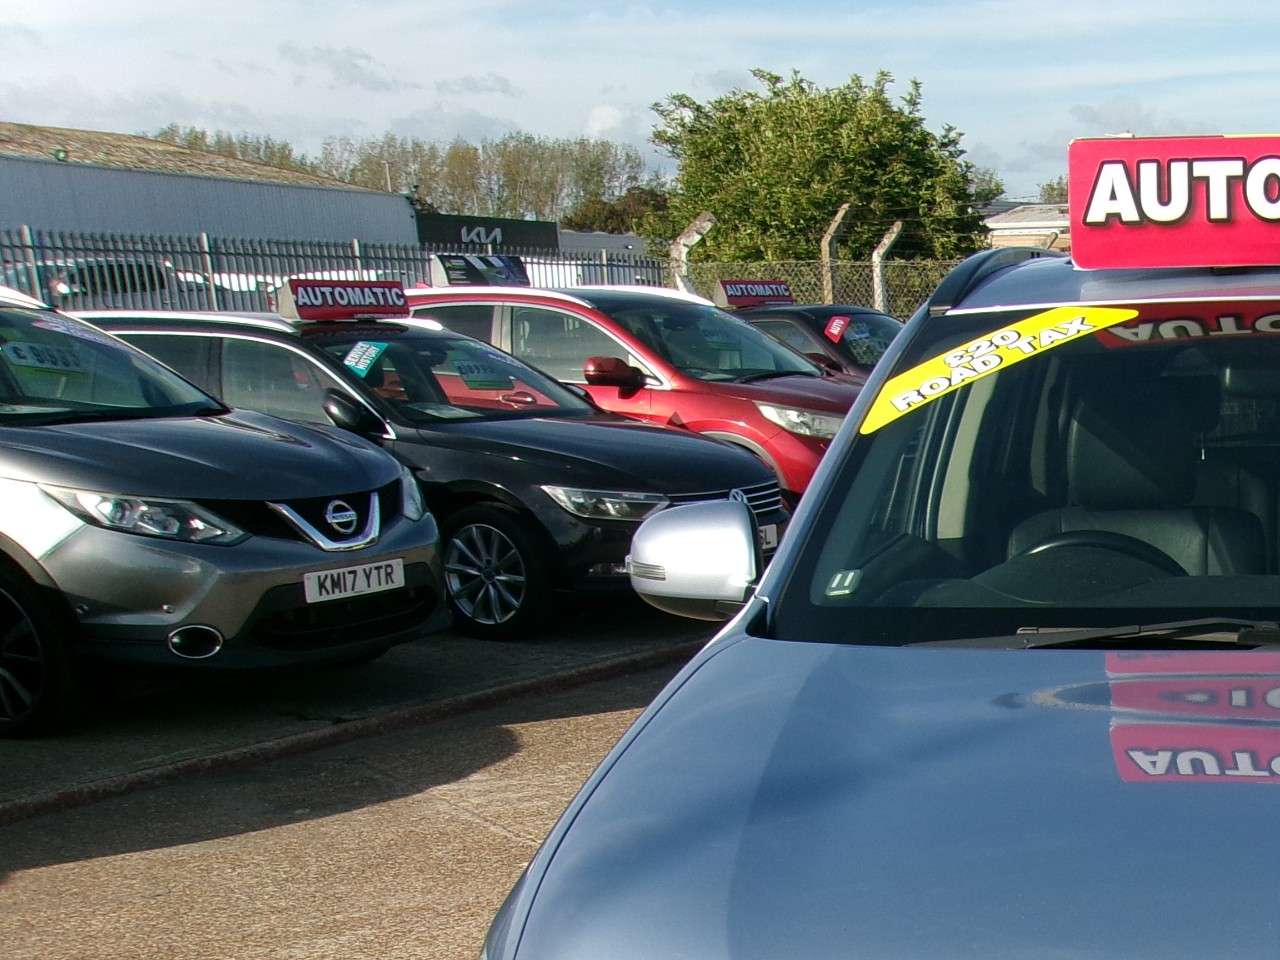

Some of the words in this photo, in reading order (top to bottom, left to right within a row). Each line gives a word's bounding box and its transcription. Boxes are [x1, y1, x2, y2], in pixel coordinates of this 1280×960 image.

[461, 226, 503, 244] KIA
[297, 286, 405, 306] AUTOMATIC
[726, 284, 790, 297] AUTOMATIC
[943, 329, 1021, 369] £20
[889, 352, 1004, 412] ROAD
[1006, 316, 1097, 355] TAX
[317, 569, 358, 597] KM17
[362, 563, 395, 588] YTR
